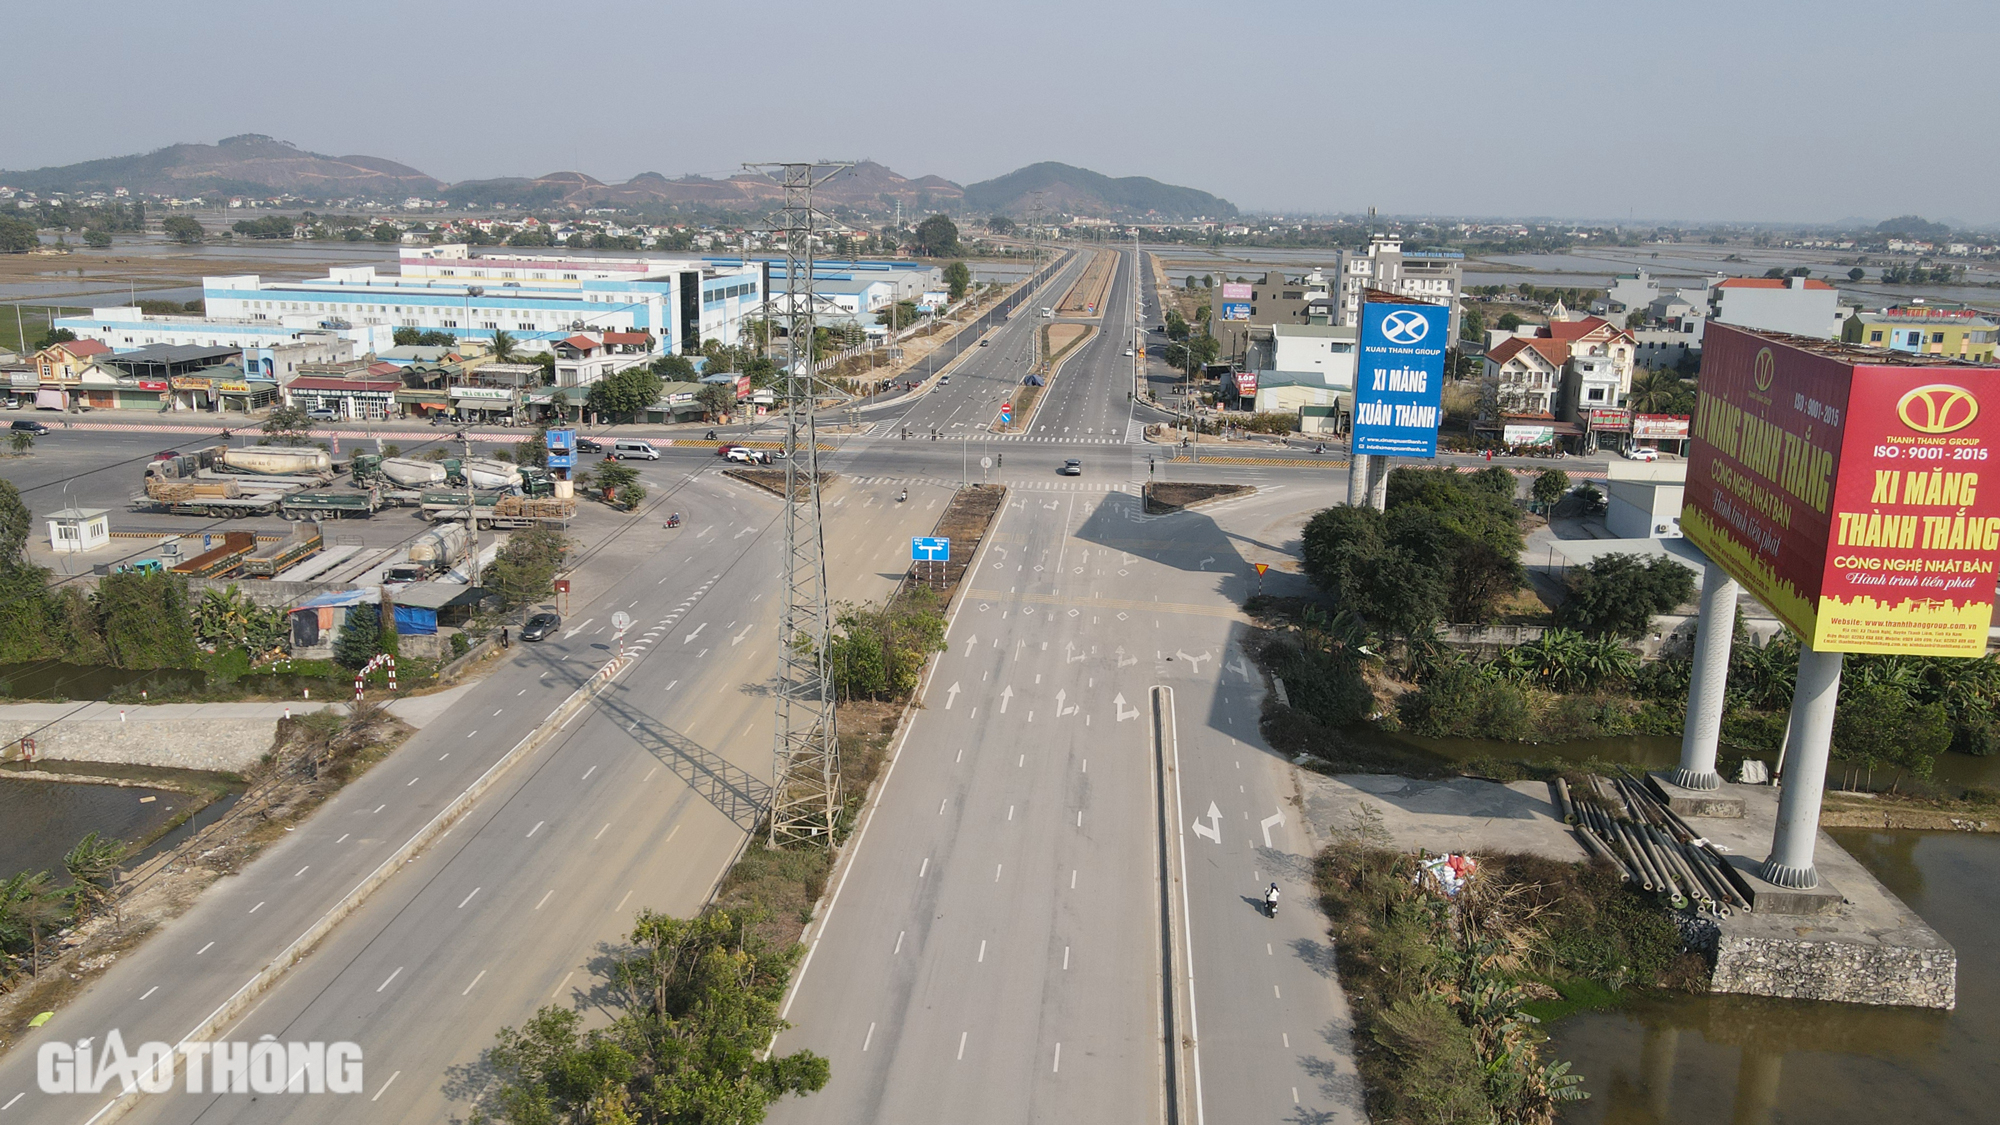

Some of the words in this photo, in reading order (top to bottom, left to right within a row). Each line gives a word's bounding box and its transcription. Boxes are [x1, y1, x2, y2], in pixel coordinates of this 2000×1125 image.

[1372, 368, 1386, 391] XI
[1388, 366, 1428, 393] MĂNG
[1356, 399, 1392, 426] XUÂN
[1395, 401, 1436, 428] THÀNH
[1794, 392, 1804, 412] ISO
[1807, 398, 1822, 420] 9001
[1823, 405, 1840, 428] 2015
[1694, 390, 1710, 440] XI
[1706, 392, 1741, 459] MĂNG
[1738, 410, 1782, 484] THÀNH
[1780, 424, 1833, 514] THẮNG
[1874, 446, 1899, 458] ISO
[1908, 447, 1944, 460] 9001
[1952, 448, 1988, 460] 2015
[1886, 436, 1915, 444] THANH
[1918, 437, 1946, 446] THANG
[1948, 438, 1980, 446] GROUP
[1711, 458, 1732, 490] CÔNG
[1732, 471, 1752, 506] NGHỆ
[1752, 483, 1773, 518] NHẬT
[1772, 494, 1792, 530] BẢN
[1871, 470, 1900, 504] XI
[1903, 467, 1978, 506] MĂNG
[1838, 508, 1918, 549] THÀNH
[1922, 507, 2000, 551] THẮNG
[1834, 555, 1881, 570] CÔNG
[1883, 558, 1923, 574] NGHỆ
[1924, 559, 1962, 574] NHẬT
[1962, 558, 1993, 574] BẢN
[1846, 572, 1886, 586] Hành
[1888, 575, 1918, 587] trình
[1920, 575, 1944, 588] tiến
[1943, 576, 1977, 590] phát
[1830, 618, 1862, 626] Website:
[1864, 620, 1977, 630] www.thanhthanggroup.com.vn
